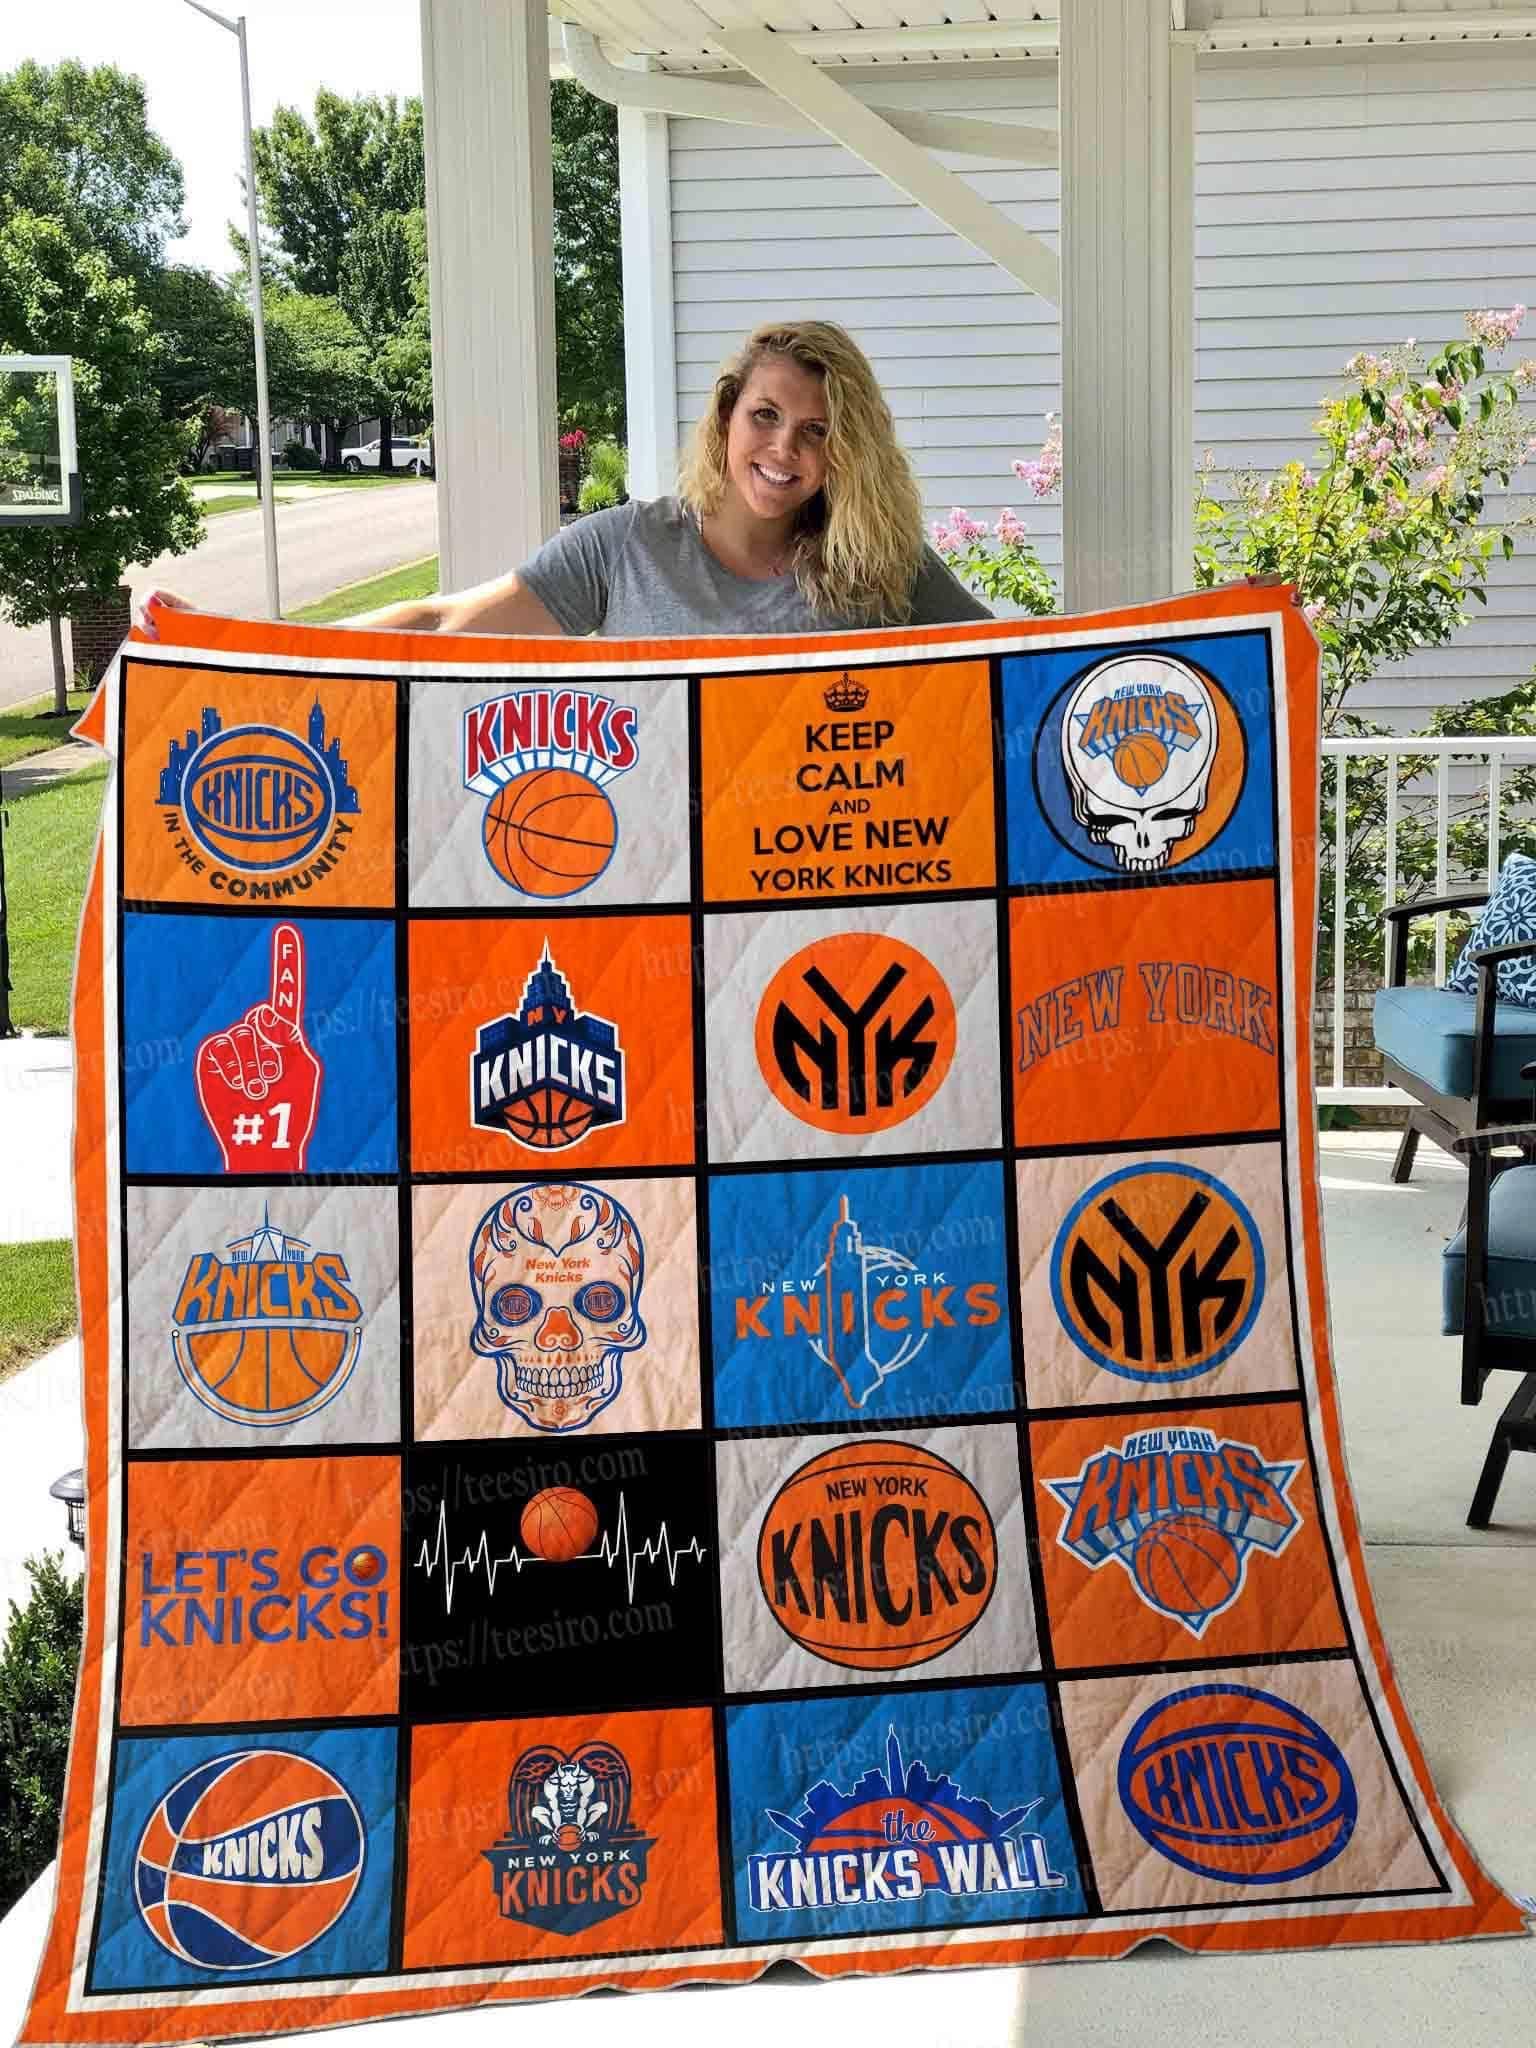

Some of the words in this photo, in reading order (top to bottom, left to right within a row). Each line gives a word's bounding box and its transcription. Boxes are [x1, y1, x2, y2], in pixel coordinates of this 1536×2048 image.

[12, 488, 61, 502] SPALDING
[1113, 686, 1136, 699] NEW
[1136, 683, 1163, 695] YORK
[464, 688, 640, 777] KNICKS
[805, 720, 894, 753] KEEP
[1079, 691, 1202, 748] KNICKS
[202, 768, 314, 831] KNICKS
[796, 758, 905, 793] CALM
[828, 798, 871, 816] AND
[163, 812, 181, 833] IN
[174, 837, 207, 875] THE
[209, 818, 353, 900] COMMUNITY
[753, 820, 852, 855] LOVE
[865, 815, 949, 850] NEW
[751, 865, 834, 893] YORK
[845, 859, 952, 888] KNICKS
[1018, 964, 1125, 1072] NEW
[1138, 961, 1276, 1056] YORK
[480, 1033, 615, 1110] KNICKS
[231, 1102, 292, 1150] #1
[172, 1252, 364, 1326] KNICKS
[525, 1259, 557, 1270] New
[561, 1257, 591, 1269] York
[535, 1271, 584, 1283] Knicks
[762, 1277, 817, 1294] NEW
[877, 1271, 946, 1287] YORK
[735, 1282, 1002, 1339] KNICKS
[1126, 1431, 1166, 1458] NEW
[1168, 1428, 1216, 1452] YORK
[826, 1479, 868, 1503] NEW
[872, 1476, 929, 1499] YORK
[1068, 1444, 1299, 1543] KNICKS
[141, 1546, 280, 1596] LET'S
[302, 1544, 388, 1592] GO
[771, 1503, 988, 1627] KNICKS
[140, 1592, 389, 1648] KNICKS!
[1143, 1738, 1327, 1830] KNICKS
[202, 1805, 326, 1880] KNICKS
[882, 1807, 937, 1844] the
[508, 1854, 562, 1870] NEW
[569, 1850, 632, 1866] YORK
[755, 1848, 923, 1914] KNICKS
[938, 1833, 1067, 1895] WALL
[501, 1864, 644, 1917] KNICKS
